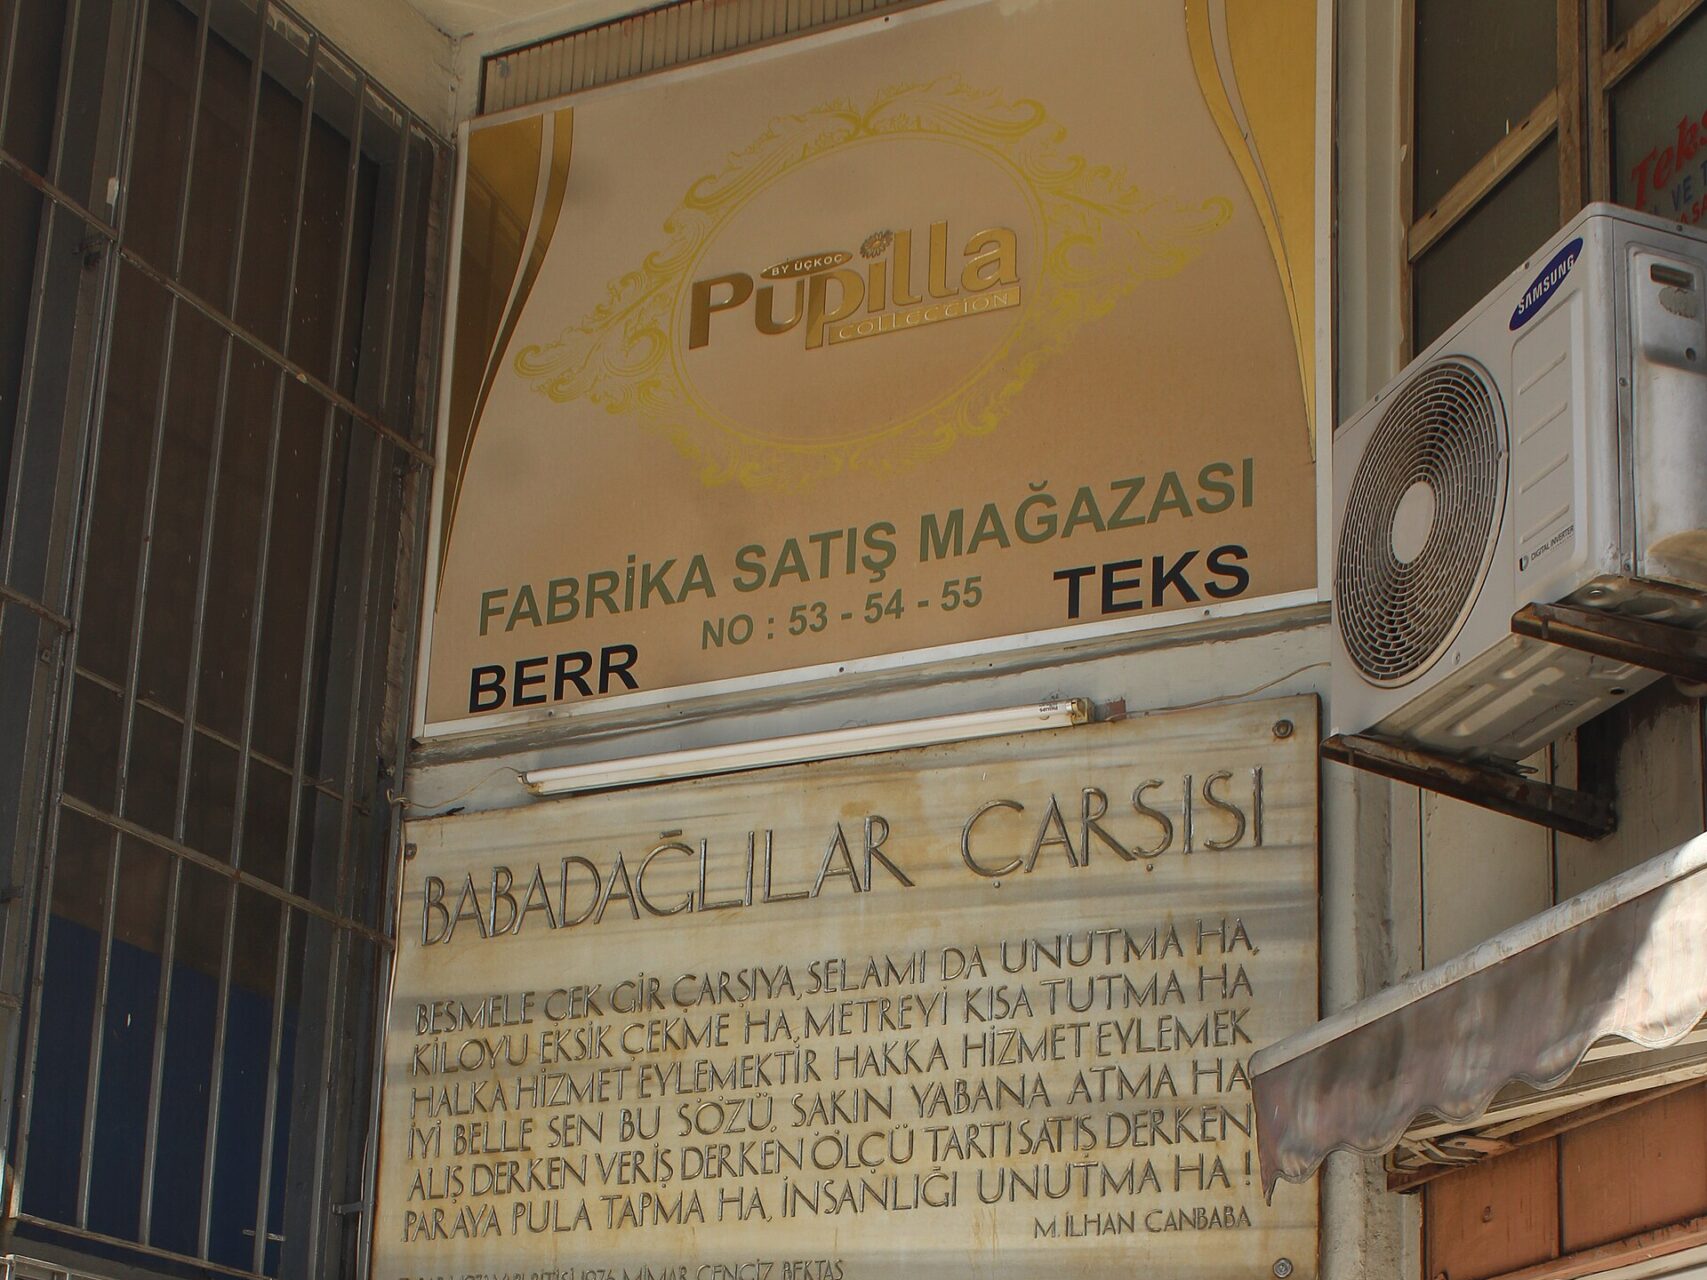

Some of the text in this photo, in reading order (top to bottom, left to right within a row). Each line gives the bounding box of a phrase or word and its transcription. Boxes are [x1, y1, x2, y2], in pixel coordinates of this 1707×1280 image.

[771, 253, 843, 277] BY ÜÇKOÇ
[1518, 254, 1575, 315] SAMSUNG
[478, 458, 1255, 637] FABRİKA SATIŞ MAĞAZASI
[1053, 543, 1251, 620] TEKS
[702, 612, 753, 651] NO
[788, 598, 828, 637] 53
[863, 588, 905, 624] 54
[940, 576, 983, 613] 55
[468, 643, 640, 715] BERR
[421, 766, 1263, 946] BABADAĞLILAR ÇARŞISI
[411, 1036, 529, 1077] KİLOYU
[539, 1021, 613, 1065] EKSİK
[620, 1013, 729, 1062] ÇEKME
[804, 985, 948, 1039] METREYİ
[964, 984, 1033, 1023] KISA
[1040, 969, 1186, 1015] TUTMA
[1198, 962, 1254, 1001] HA
[415, 991, 536, 1037] BESMELE
[543, 983, 605, 1027] ÇEK
[609, 972, 665, 1014] GİR
[805, 949, 926, 995] SELAMI
[941, 945, 987, 982] DA
[1000, 923, 1184, 974] UNUTMA
[1196, 916, 1260, 956] HA,
[408, 1119, 442, 1160] İYİ
[453, 1117, 533, 1156] BELLE
[547, 1111, 603, 1148] SEN
[619, 1105, 661, 1142] BU
[792, 1086, 892, 1128] SAKIN
[911, 1072, 1052, 1118] YABANA
[1067, 1062, 1177, 1104] ATMA
[1192, 1057, 1252, 1095] HA
[410, 1007, 1253, 1119] HALKA HİZMET EYLEMEKTİR HAKKA HİZMET EYLEMEK
[402, 1203, 502, 1243] PARAYA
[512, 1198, 592, 1236] PULA
[599, 1189, 705, 1229] TAPMA
[781, 1166, 957, 1218] İNSANLIĞI
[976, 1158, 1162, 1204] UNUTMA
[1174, 1152, 1231, 1192] HA
[408, 1103, 1252, 1204] ALIŞ DERKEN VERİŞ DERKEN ÖLÇÜ TARTI SATIŞ DERKEN
[1145, 1204, 1252, 1233] CANBABA
